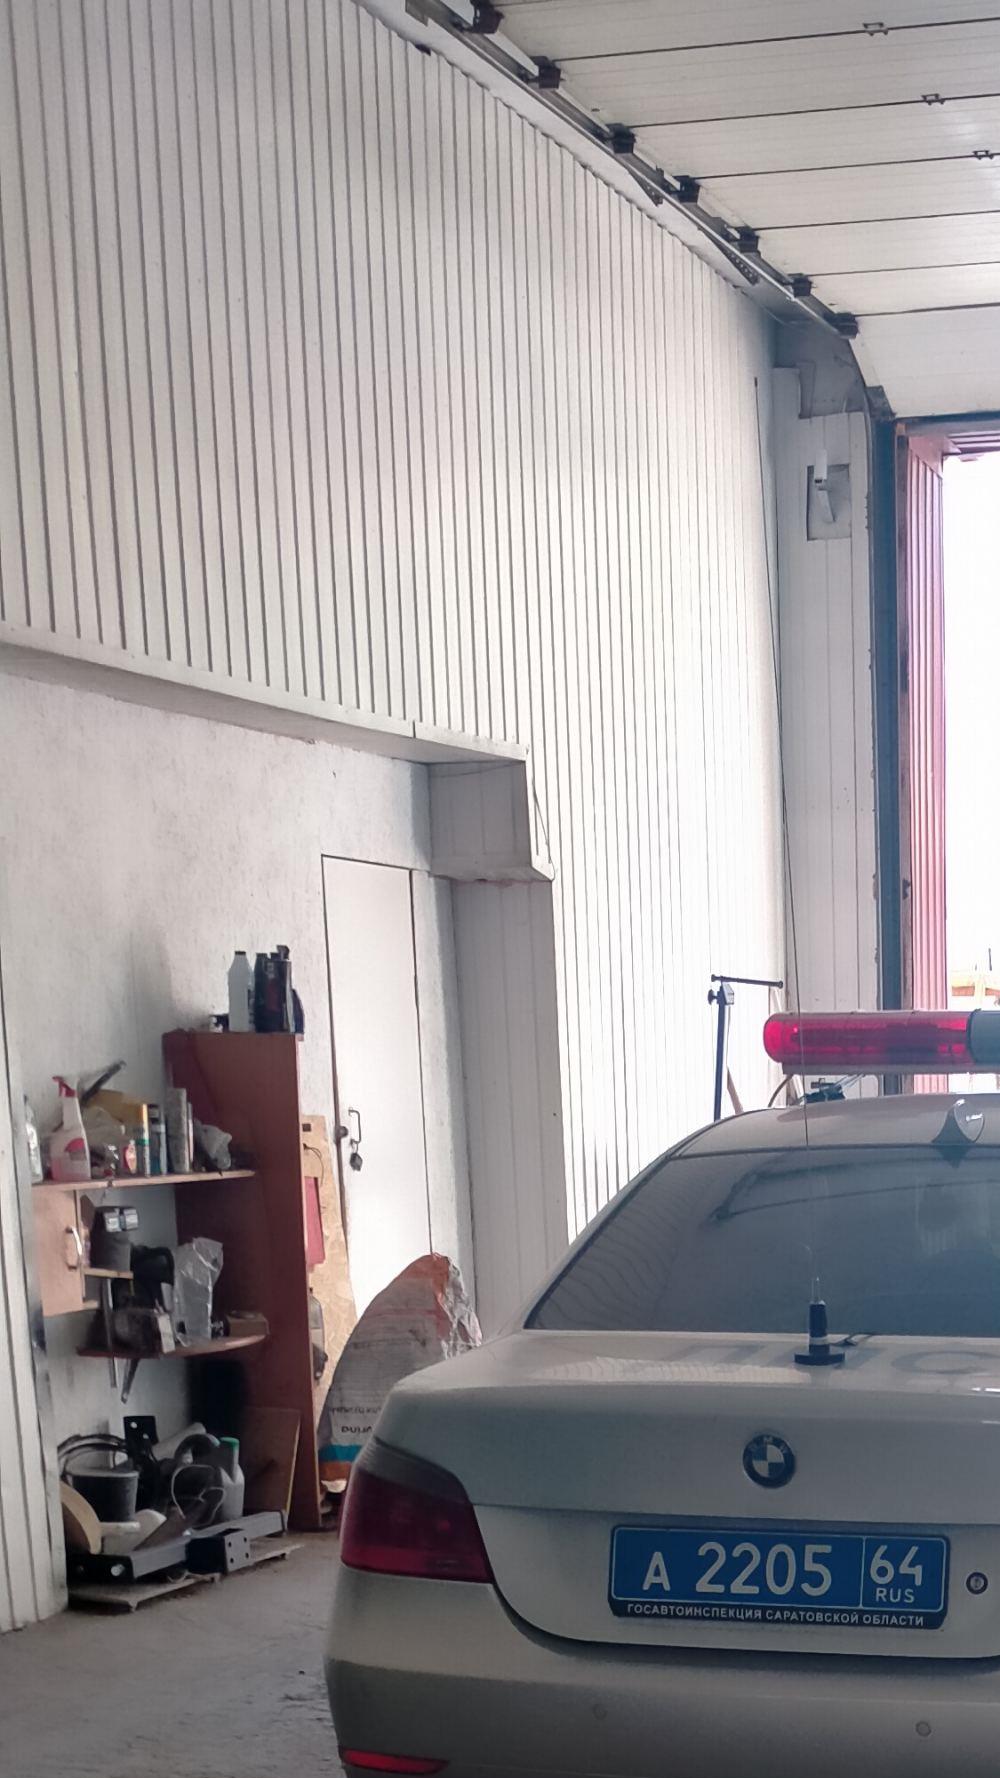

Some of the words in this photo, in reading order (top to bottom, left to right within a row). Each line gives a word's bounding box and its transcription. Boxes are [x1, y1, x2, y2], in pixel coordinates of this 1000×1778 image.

[642, 1551, 671, 1591] А
[695, 1541, 832, 1597] 2205
[870, 1544, 923, 1587] 64
[875, 1587, 915, 1604] RUS
[627, 1603, 762, 1621] ГОСАВТОИНСПЕКЦИЯ
[765, 1608, 859, 1625] САРАТОВСКОЙ
[862, 1613, 924, 1627] ОБЛАСТИ
